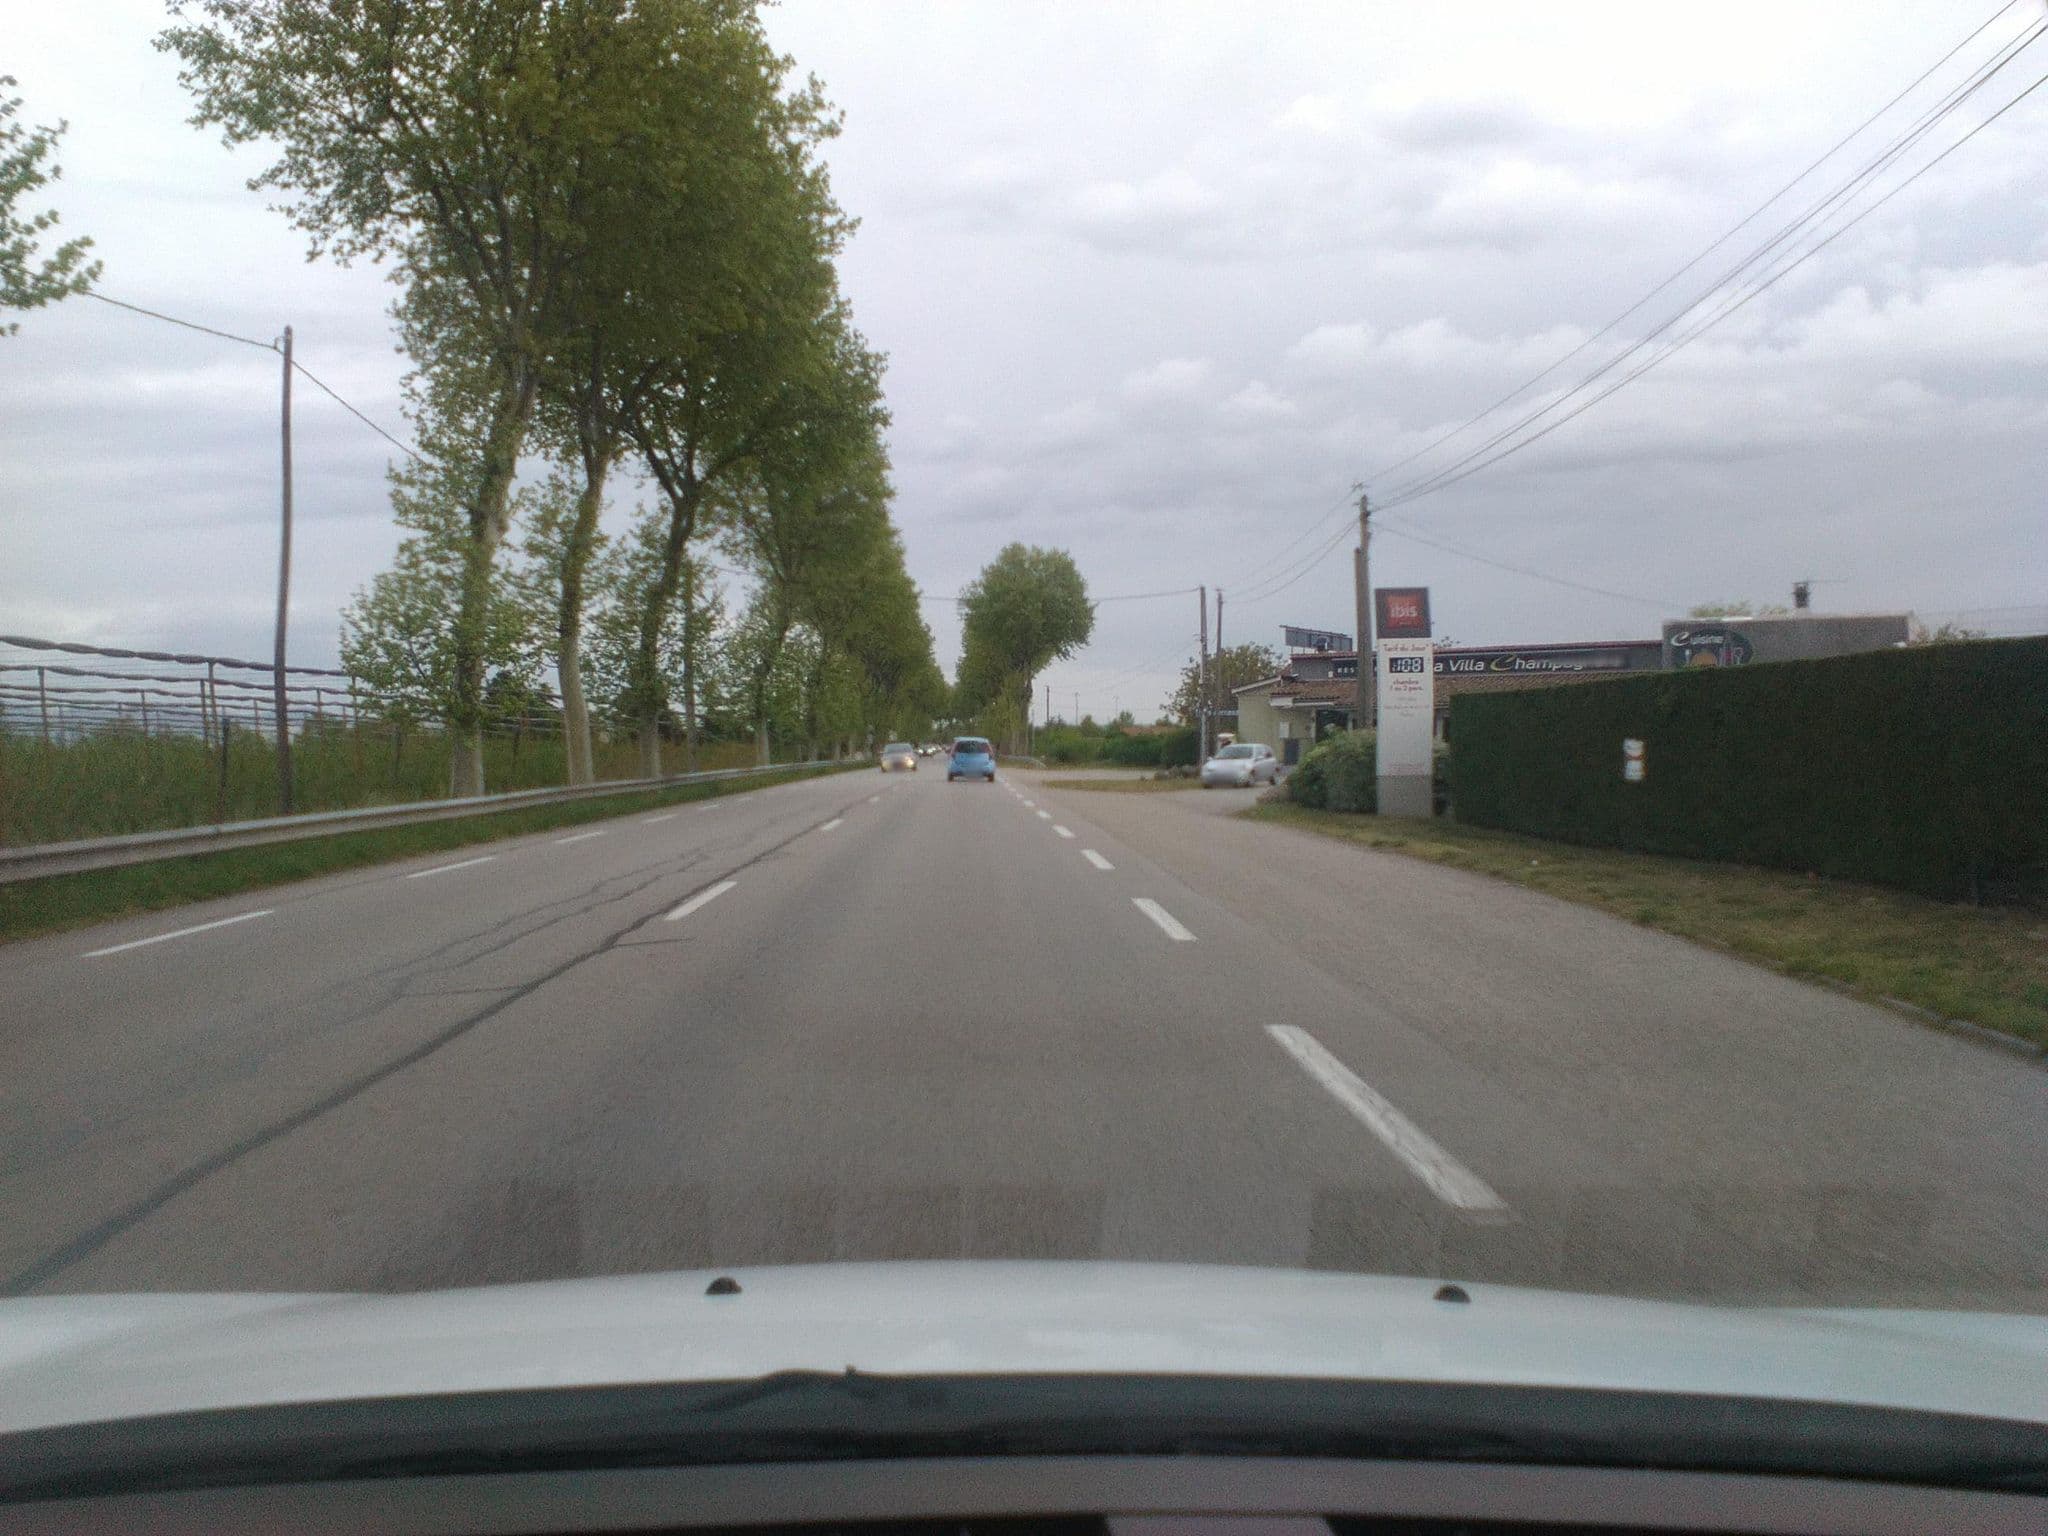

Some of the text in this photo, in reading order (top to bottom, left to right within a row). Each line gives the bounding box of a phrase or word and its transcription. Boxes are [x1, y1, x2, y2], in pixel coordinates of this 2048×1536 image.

[1390, 602, 1418, 618] ibis
[1434, 662, 1444, 672] a
[1449, 659, 1485, 672] Villa
